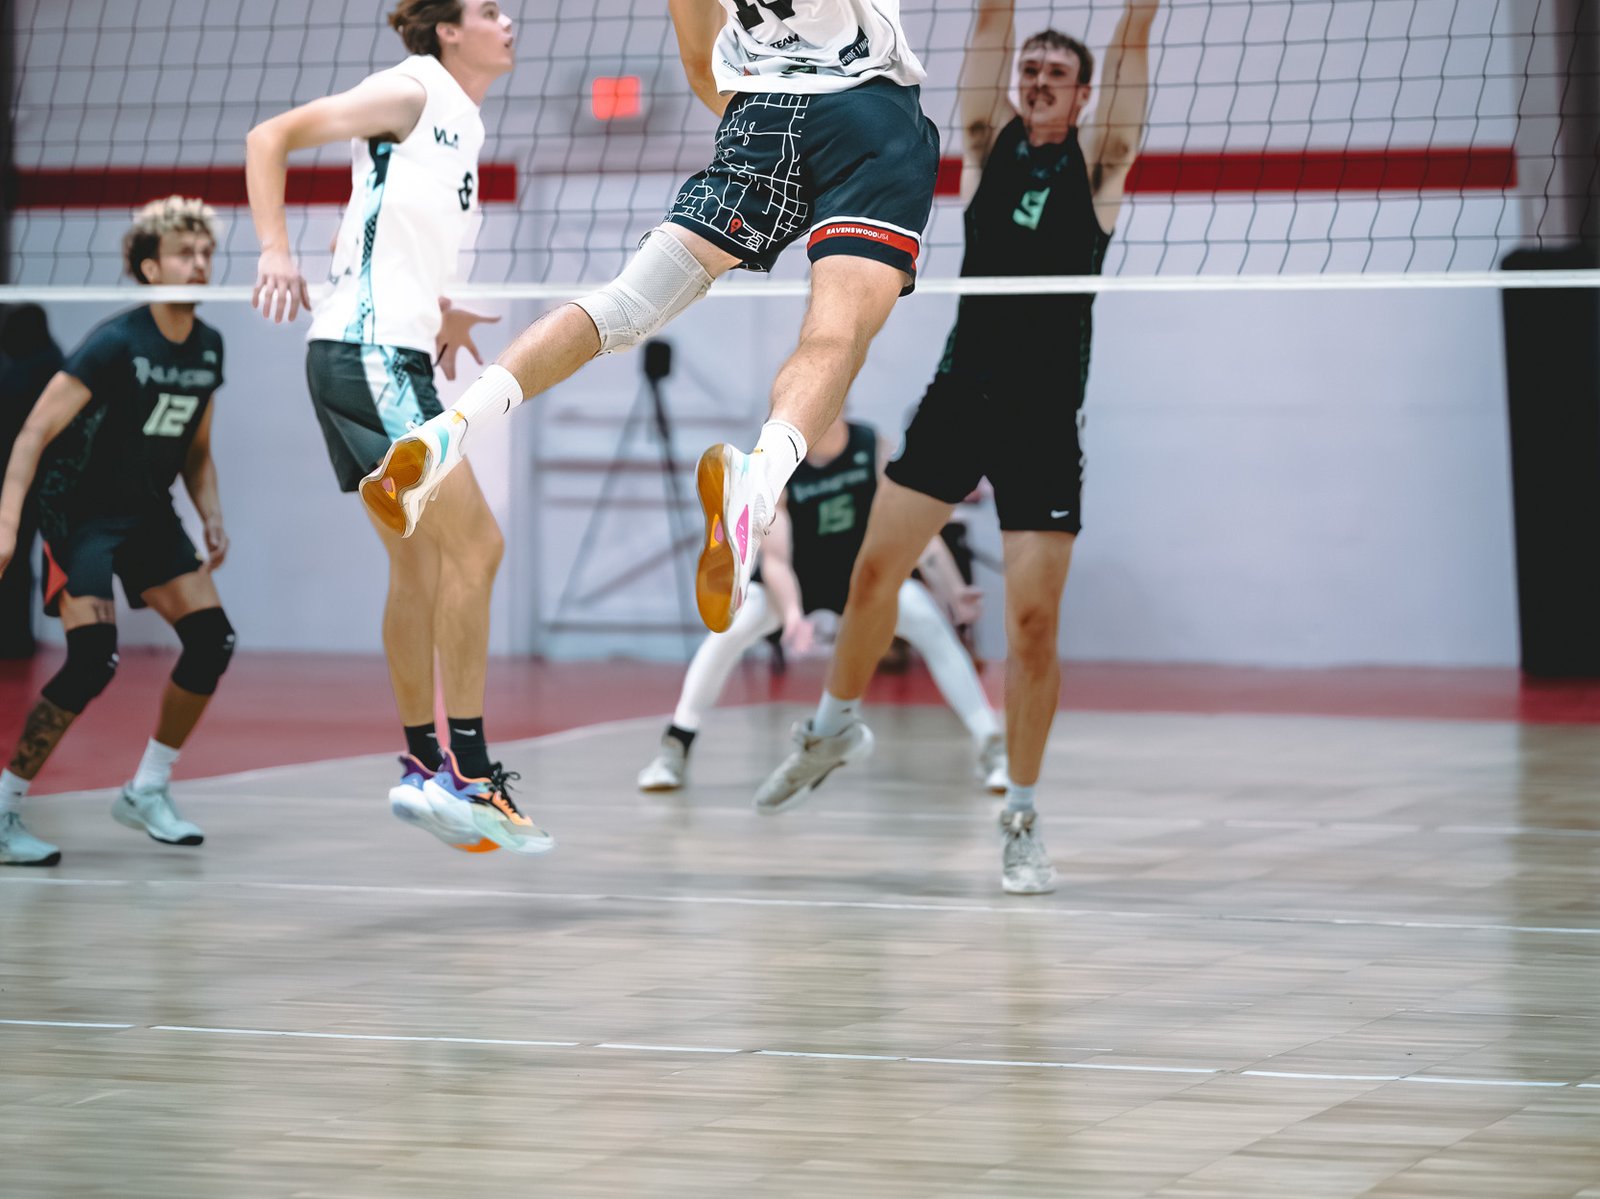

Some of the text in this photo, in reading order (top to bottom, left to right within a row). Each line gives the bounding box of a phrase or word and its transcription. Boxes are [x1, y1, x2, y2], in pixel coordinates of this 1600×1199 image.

[769, 33, 801, 49] TEAM
[1012, 187, 1050, 231] 9
[142, 393, 199, 437] 12
